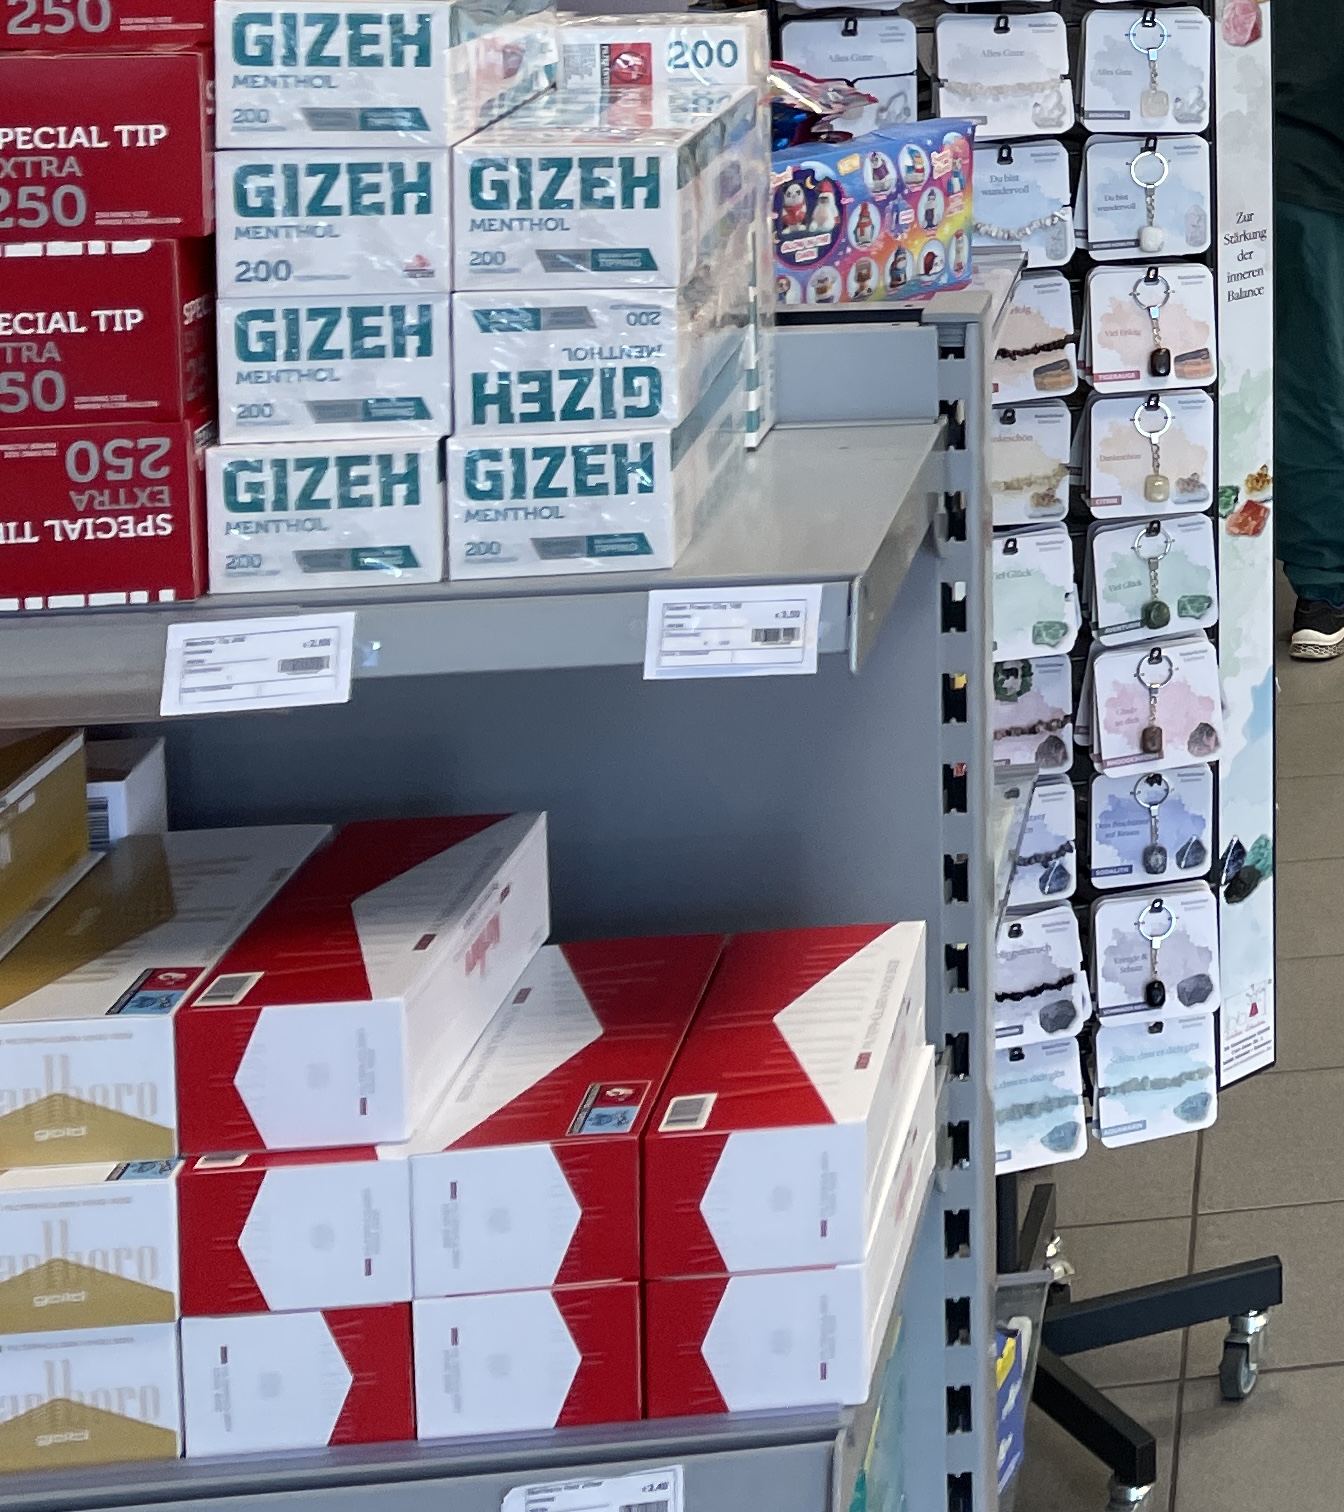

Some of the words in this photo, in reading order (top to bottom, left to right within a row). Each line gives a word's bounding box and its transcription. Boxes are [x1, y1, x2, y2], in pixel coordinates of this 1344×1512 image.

[231, 12, 433, 67] GIZEH
[666, 39, 740, 71] 200
[232, 74, 338, 89] MENTHOL
[113, 124, 168, 146] TIP
[233, 161, 432, 217] GIZEH
[467, 156, 662, 211] GIZEH
[468, 216, 571, 234] MENTHOL
[1236, 211, 1255, 225] Zur
[1223, 227, 1268, 246] Stärkung
[1237, 248, 1255, 262] der
[234, 260, 292, 282] 200
[1226, 267, 1265, 284] inneren
[1227, 284, 1265, 302] Balance
[91, 308, 145, 332] TIP
[234, 304, 434, 363] GIZEH
[236, 368, 340, 385] MENTHOL
[470, 365, 664, 425] GIZEH
[65, 436, 171, 484] 250
[463, 441, 656, 502] GIZEH
[222, 452, 421, 514] GIZEH
[70, 486, 171, 512] EXTRA
[44, 514, 173, 541] SPECIAL
